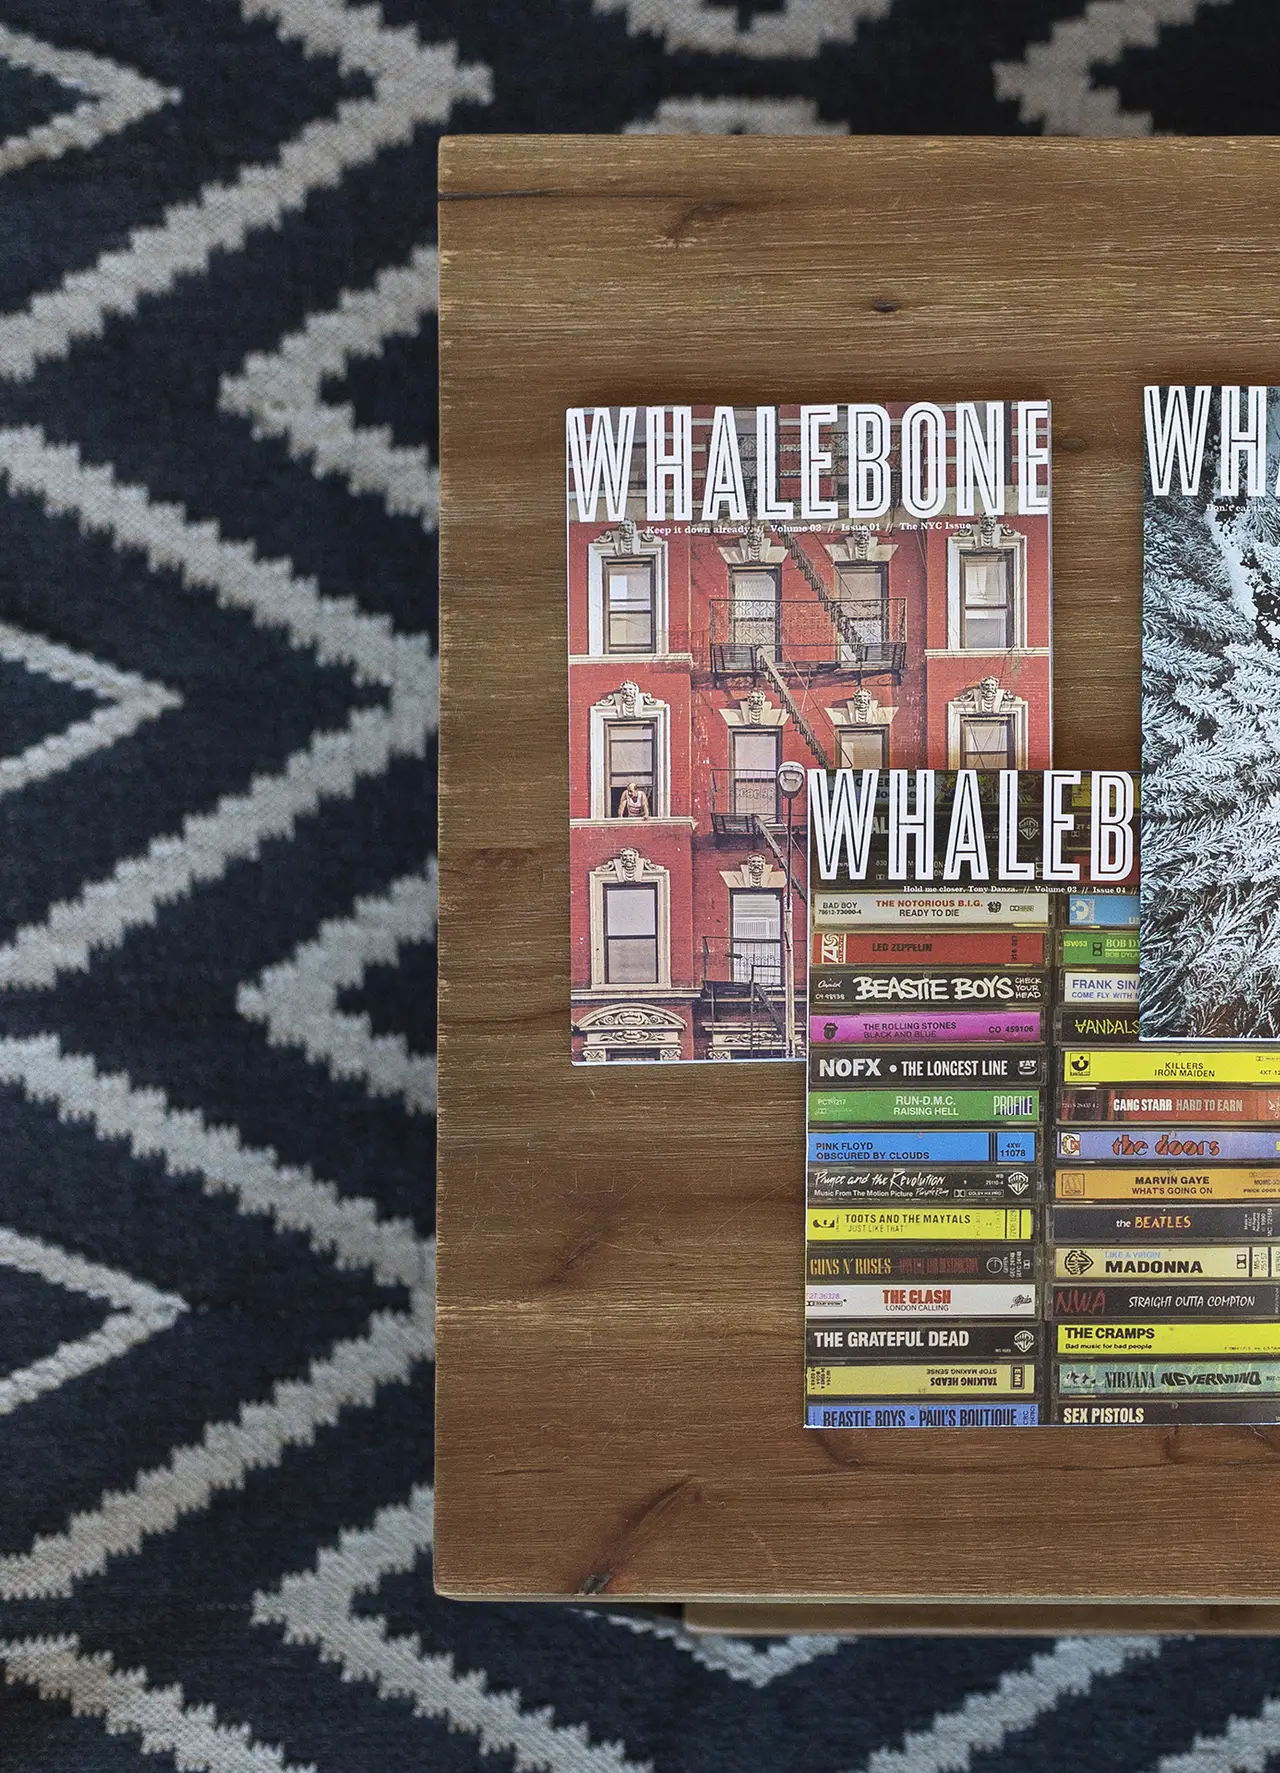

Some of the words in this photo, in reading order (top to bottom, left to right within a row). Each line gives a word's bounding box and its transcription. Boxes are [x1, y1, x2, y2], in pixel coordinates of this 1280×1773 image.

[566, 401, 1049, 522] WHALEBONE
[1206, 503, 1233, 512] Don't
[647, 526, 671, 536] Keep
[674, 526, 682, 534] it
[685, 526, 711, 534] down
[770, 524, 807, 533] Volume
[841, 523, 869, 532] Issue
[871, 523, 880, 532] 01
[900, 522, 917, 531] The
[920, 522, 942, 531] NYC
[945, 522, 971, 531] Issue
[807, 768, 1135, 881] WHALEB
[968, 886, 989, 895] Tony
[899, 909, 929, 917] READY
[931, 909, 943, 917] TO
[945, 909, 960, 917] DIE
[872, 944, 888, 952] LED
[891, 944, 932, 952] ZEPPELIN
[1106, 938, 1126, 948] BOB
[853, 976, 950, 1000] BEASTIE
[951, 975, 1014, 999] BOYS
[1072, 980, 1112, 989] FRANK
[1015, 991, 1042, 999] HEAD
[1075, 1019, 1140, 1035] VANDALS
[819, 1059, 882, 1077] NOFX
[901, 1061, 924, 1077] THE
[927, 1060, 979, 1076] LONGEST
[982, 1060, 1008, 1076] LINE
[1165, 1062, 1204, 1070] KILLERS
[896, 1096, 956, 1106] RUN-D.M.C.
[993, 1095, 1033, 1116] PROFILE
[1113, 1099, 1140, 1111] GANG
[1141, 1099, 1172, 1111] STARR
[1176, 1099, 1202, 1111] HARD
[1205, 1099, 1216, 1111] TO
[1217, 1099, 1243, 1111] EARN
[894, 1108, 932, 1116] RAISING
[934, 1108, 959, 1116] HELL
[816, 1142, 839, 1150] PINK
[841, 1142, 873, 1150] FLOYD
[1112, 1135, 1149, 1156] the
[1155, 1135, 1220, 1156] doors
[816, 1152, 870, 1160] OBSCURED
[873, 1152, 886, 1160] BY
[889, 1152, 930, 1160] CLOUDS
[1000, 1149, 1026, 1157] 11078
[847, 1173, 870, 1185] and
[871, 1173, 888, 1187] the
[888, 1170, 947, 1190] Revolution
[1135, 1176, 1178, 1184] MARVIN
[1180, 1176, 1209, 1184] GAYE
[845, 1214, 876, 1224] TOOTS
[880, 1214, 900, 1224] AND
[902, 1214, 921, 1224] THE
[923, 1214, 971, 1224] MAYTALS
[1116, 1219, 1131, 1228] the
[1135, 1215, 1191, 1228] BEATLES
[810, 1258, 840, 1275] GUNS
[855, 1258, 892, 1275] ROSES
[1105, 1260, 1203, 1274] MADONNA
[883, 1289, 906, 1304] THE
[908, 1289, 951, 1304] CLASH
[1128, 1296, 1173, 1308] STRAIGHT
[1175, 1296, 1204, 1308] OUTTA
[1207, 1296, 1255, 1308] COMPTON
[918, 1304, 949, 1312] CALLING
[814, 1332, 843, 1347] THE
[848, 1331, 924, 1347] GRATEFUL
[928, 1331, 969, 1347] DEAD
[1065, 1328, 1093, 1339] THE
[1095, 1328, 1155, 1339] CRAMPS
[1128, 1343, 1152, 1351] people
[930, 1377, 958, 1386] HEADS
[960, 1377, 997, 1386] TALKING
[1014, 1367, 1022, 1388] EMI
[1104, 1371, 1156, 1388] NIRVANA
[1160, 1371, 1262, 1387] NEVERMIND
[823, 1410, 871, 1426] BEASTIE
[875, 1410, 906, 1426] BOYS
[919, 1409, 956, 1426] PAUL'S
[960, 1408, 1017, 1425] BOUTIQUE
[1063, 1407, 1090, 1424] SEX
[1092, 1407, 1144, 1424] PISTOLS
